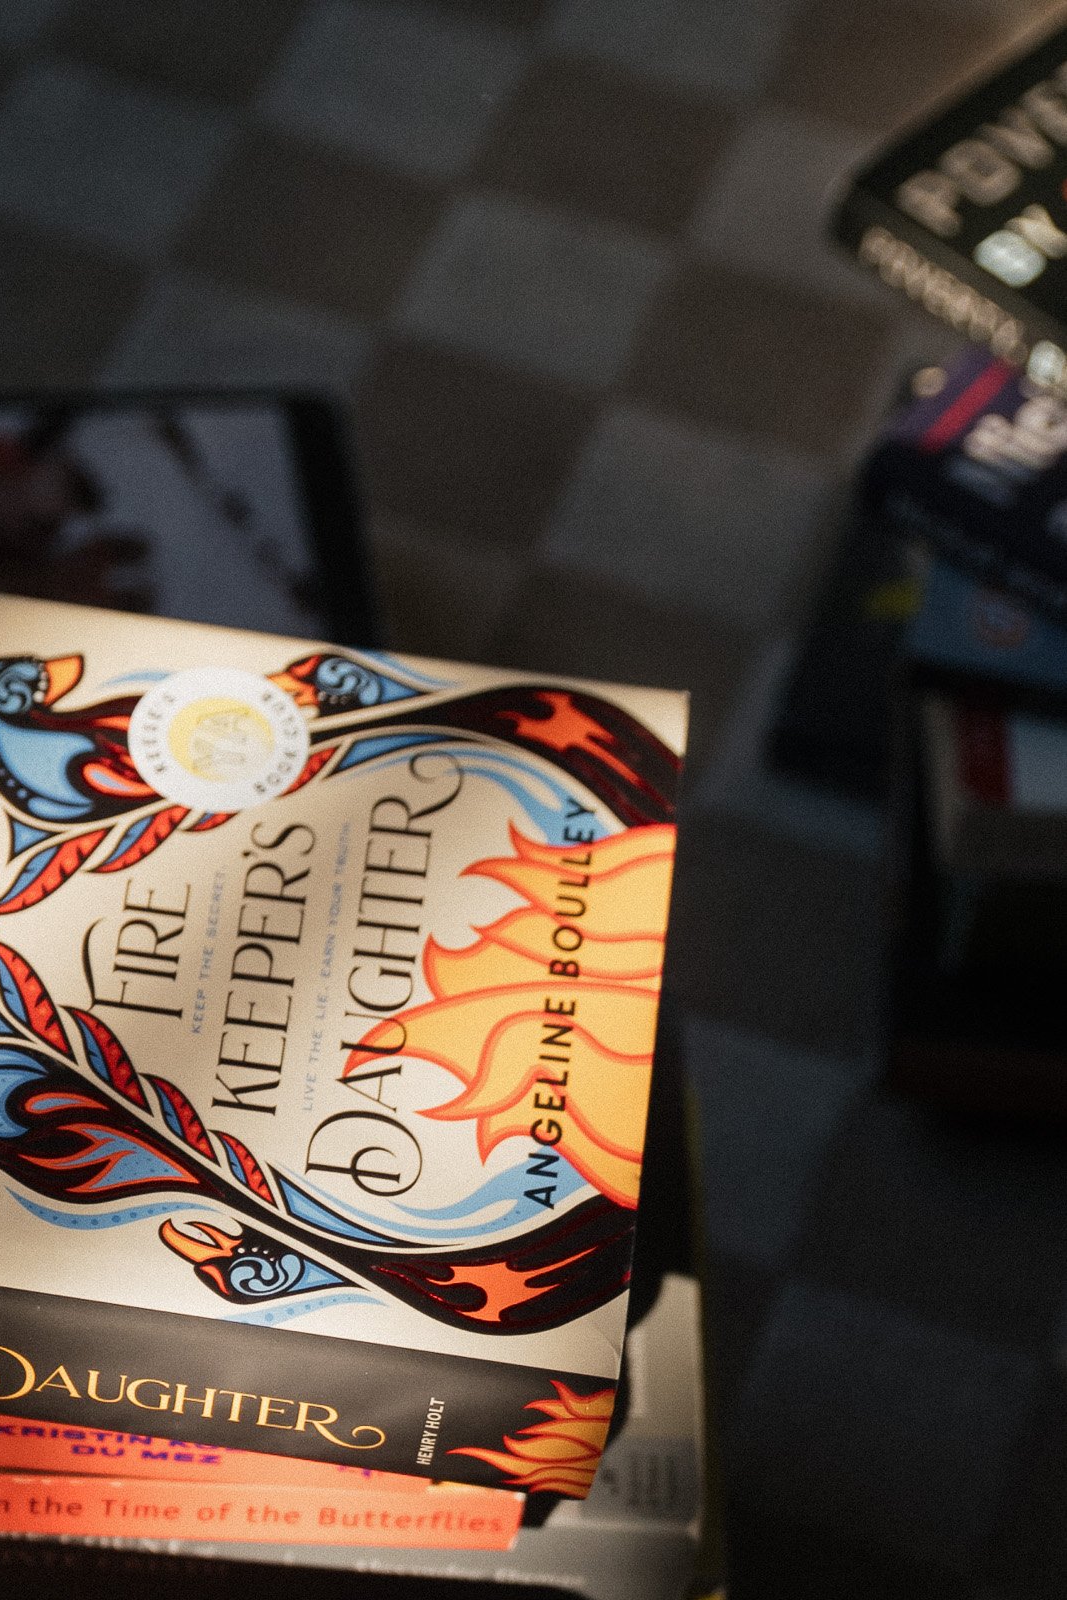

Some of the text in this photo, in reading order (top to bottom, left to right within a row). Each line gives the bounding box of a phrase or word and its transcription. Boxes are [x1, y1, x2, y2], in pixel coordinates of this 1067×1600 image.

[83, 878, 191, 1021] FIRE
[212, 821, 317, 1116] KEEPER'S
[304, 752, 465, 1198] DAUGHTER
[191, 988, 207, 1035] KEEP
[199, 947, 214, 980] THE
[523, 799, 597, 1210] ANGELINE BOULLEY
[308, 1029, 323, 1064] THE
[301, 1072, 317, 1112] LIVE
[71, 1444, 223, 1466] DU MEZ
[416, 1397, 447, 1467] HENRY HOLT
[28, 1494, 85, 1519] the
[101, 1498, 181, 1523] Time
[196, 1502, 232, 1524] of
[246, 1504, 302, 1528] the
[317, 1504, 505, 1535] Butterflies
